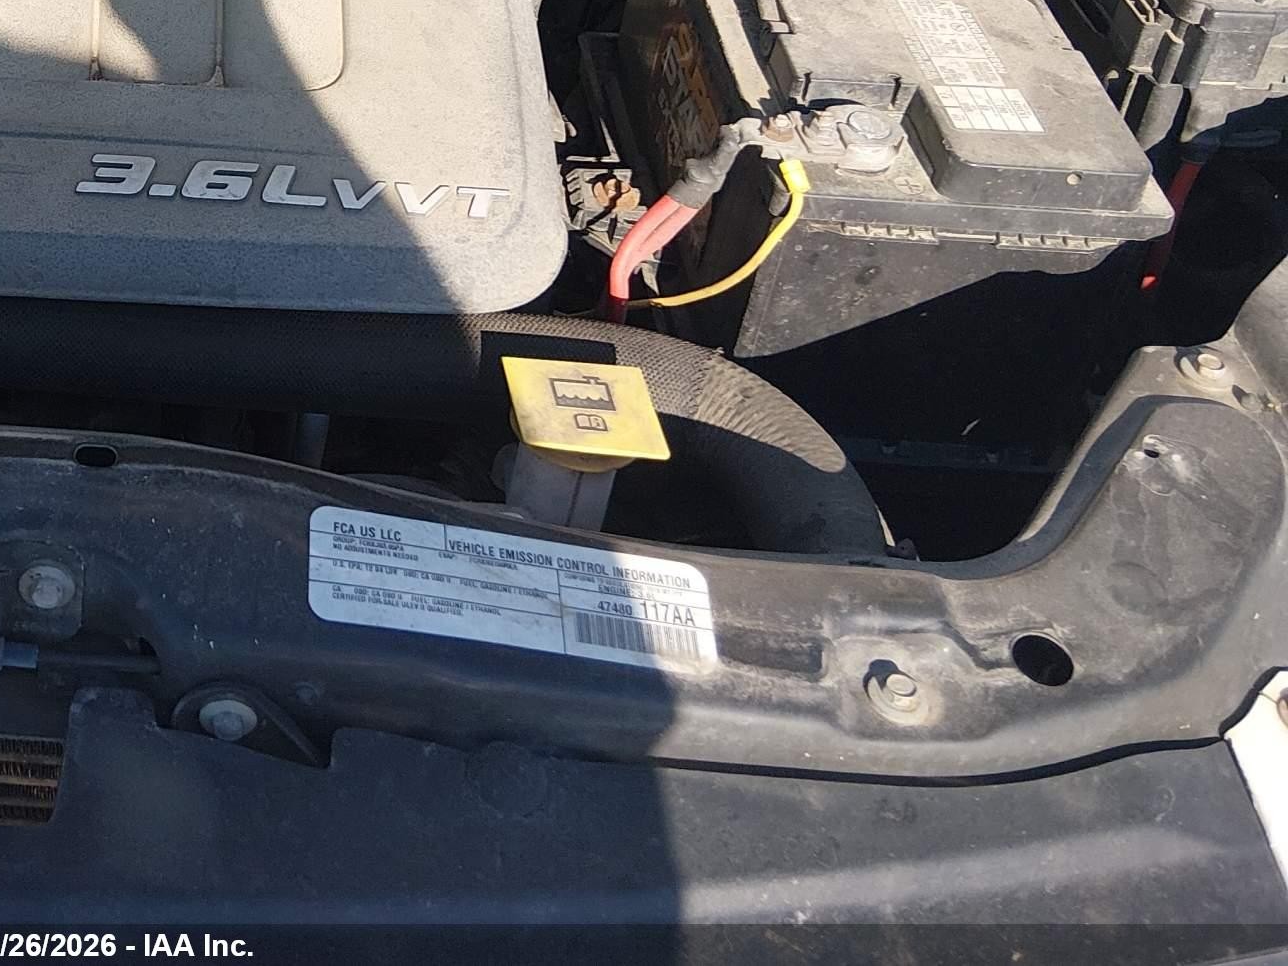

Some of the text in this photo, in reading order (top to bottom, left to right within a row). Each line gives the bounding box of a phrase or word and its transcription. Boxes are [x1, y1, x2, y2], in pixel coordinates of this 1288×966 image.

[333, 521, 402, 542] FCA US LLC
[448, 539, 494, 557] VEHICLE
[499, 548, 553, 567] EMISSION
[556, 557, 609, 576] CONTROL
[612, 566, 691, 589] INFORMATION
